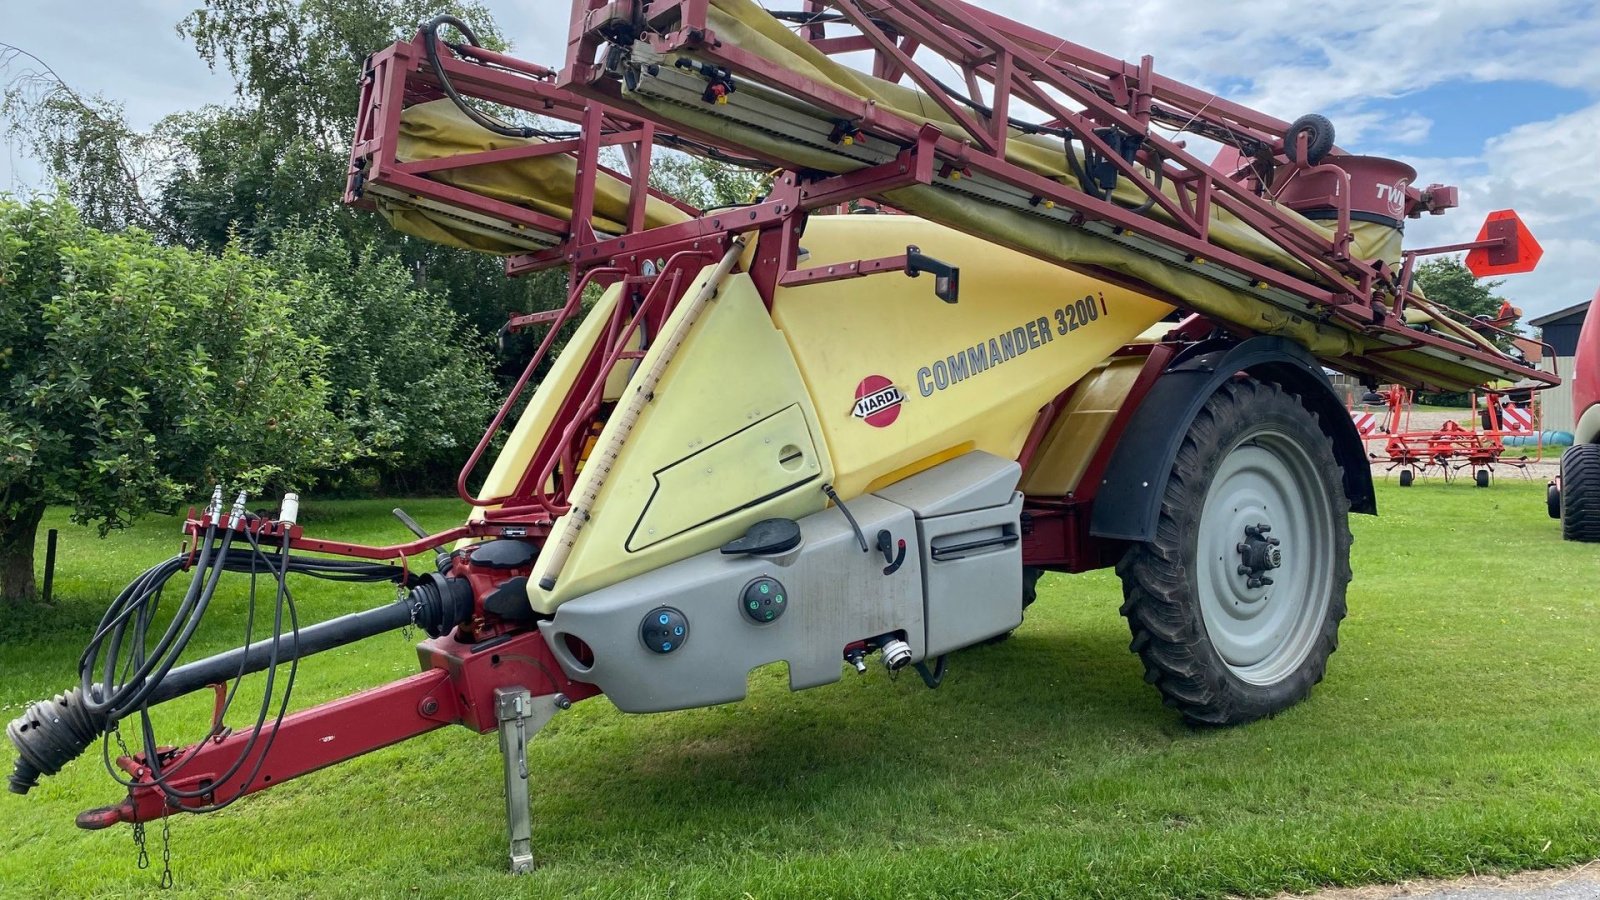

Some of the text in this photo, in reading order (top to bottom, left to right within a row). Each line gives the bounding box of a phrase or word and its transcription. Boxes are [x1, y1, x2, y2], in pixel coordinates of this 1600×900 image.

[917, 292, 1108, 397] COMMANDER 3200 i
[858, 389, 899, 414] HARDI
